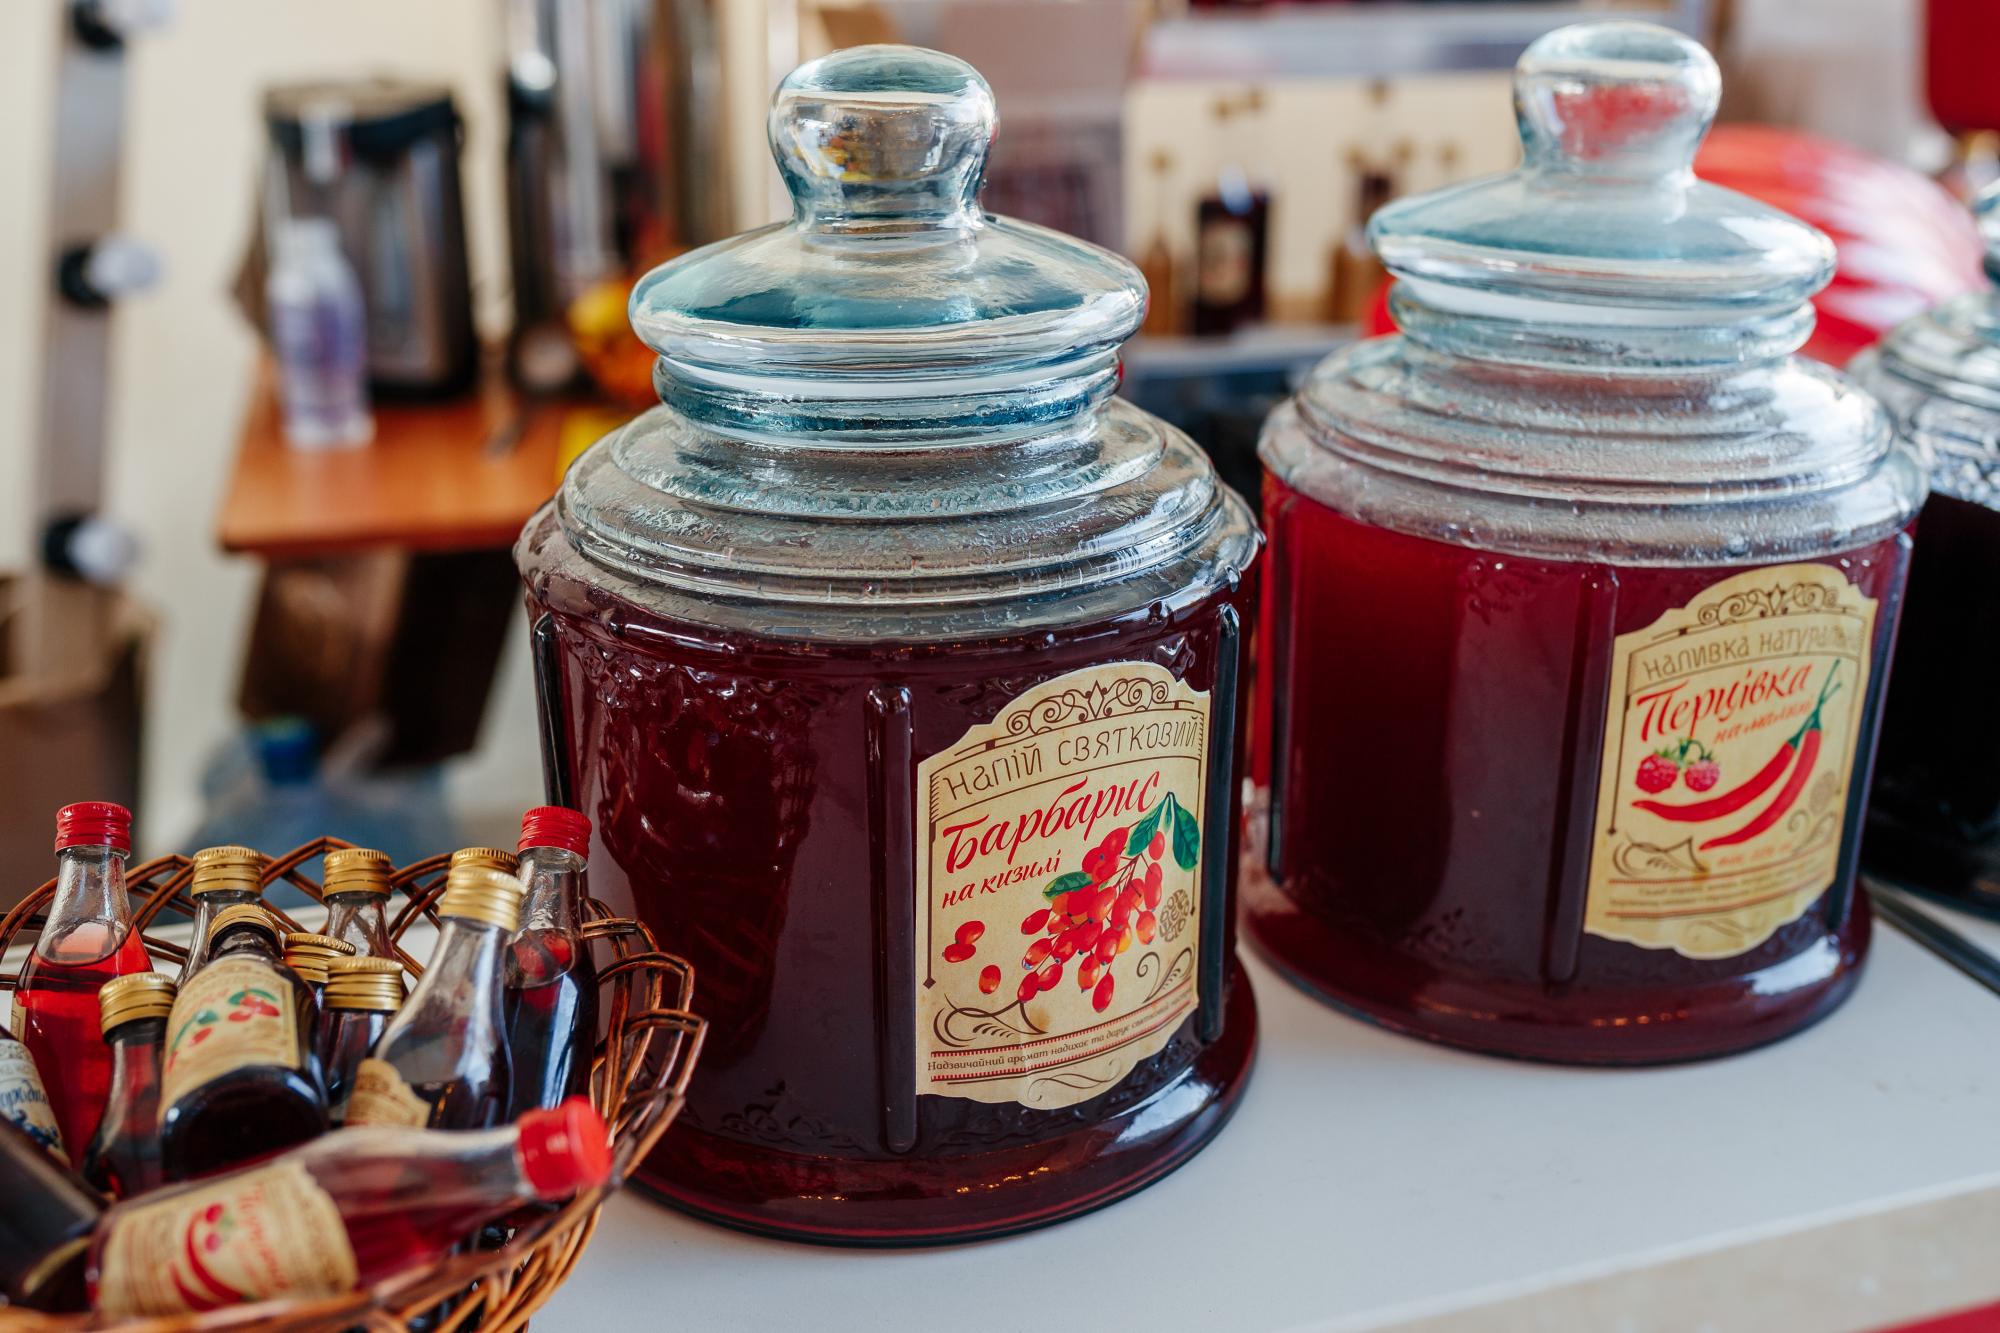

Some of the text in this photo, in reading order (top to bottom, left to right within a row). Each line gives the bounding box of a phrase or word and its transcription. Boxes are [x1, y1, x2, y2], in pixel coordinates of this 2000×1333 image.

[1636, 663, 1813, 742] Перцівка
[942, 771, 1160, 874] Барбарис
[942, 849, 1062, 909] на кизилі
[927, 1055, 1005, 1071] Надзвичайний
[1007, 1050, 1048, 1067] аромат
[1051, 1038, 1089, 1056] надихає
[1091, 1035, 1105, 1045] та
